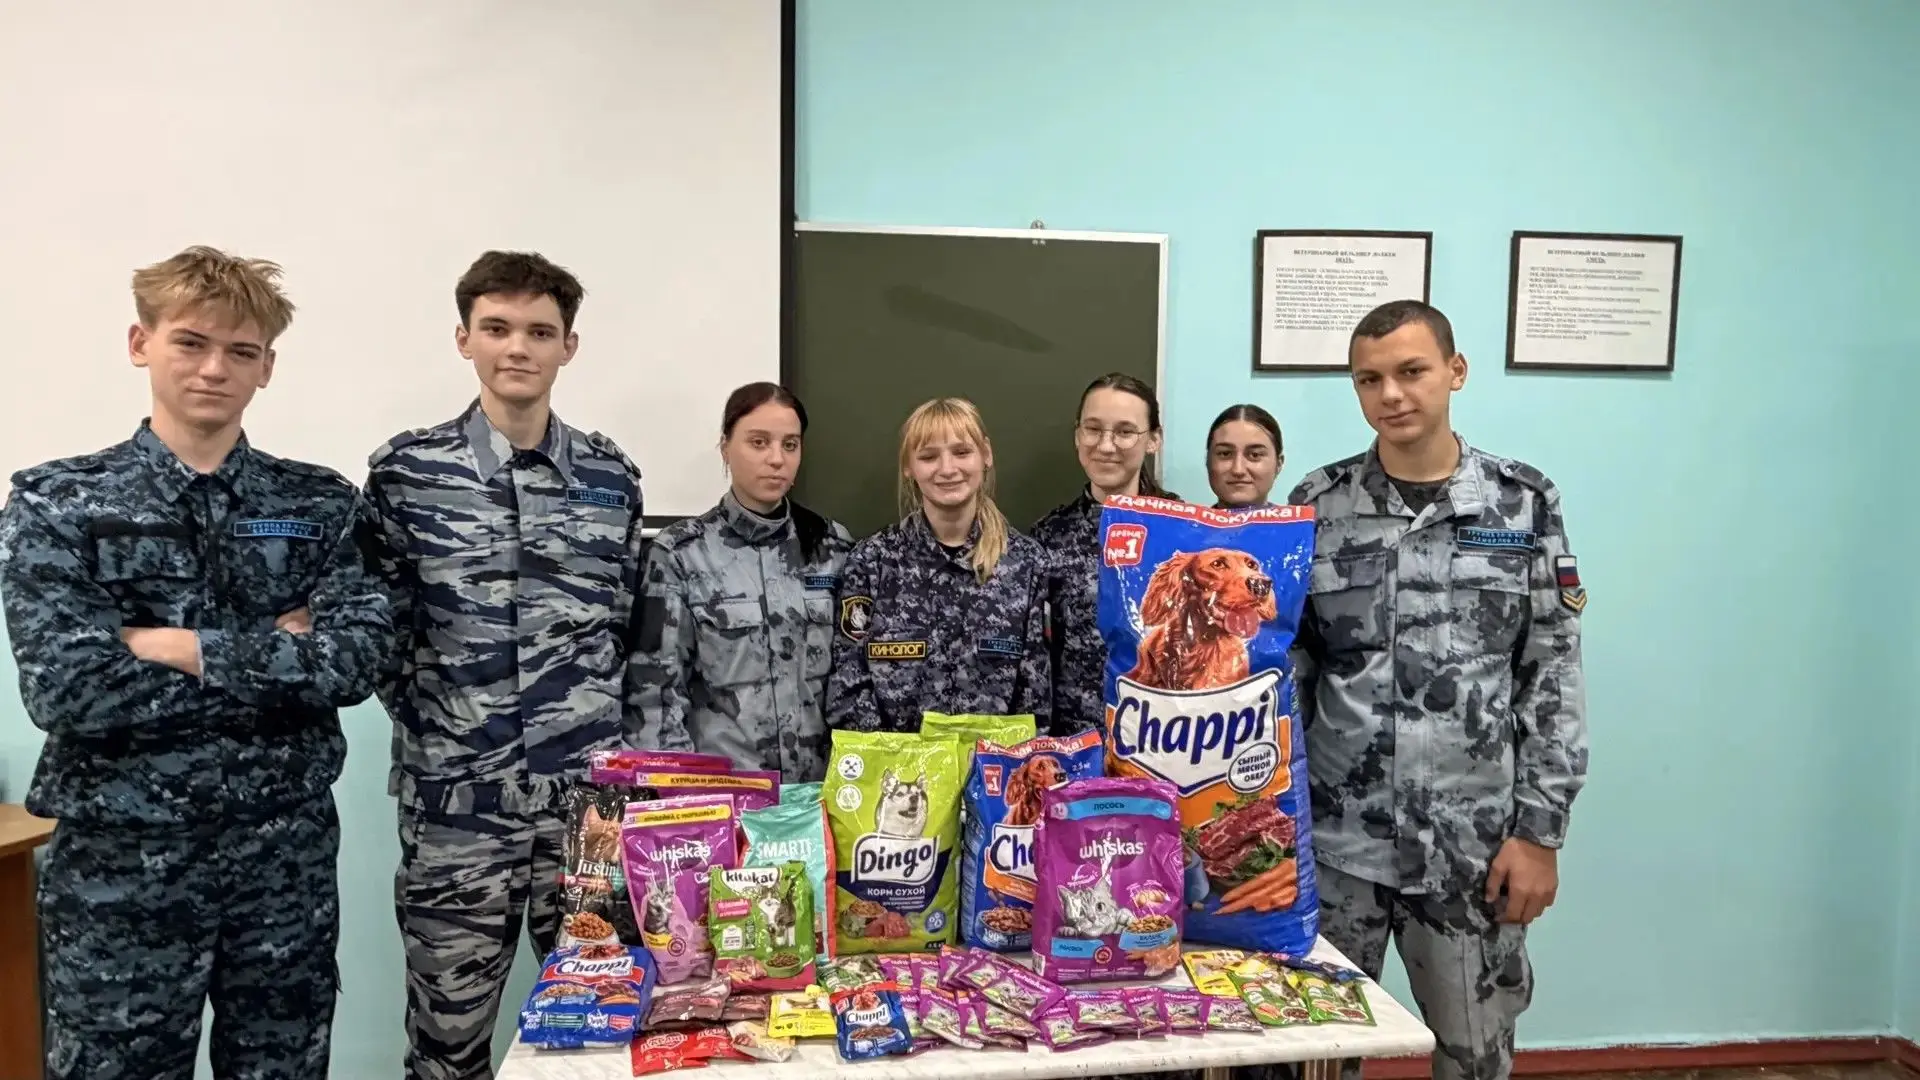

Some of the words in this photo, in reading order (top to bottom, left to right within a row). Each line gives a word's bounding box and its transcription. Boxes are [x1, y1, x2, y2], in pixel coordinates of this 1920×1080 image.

[871, 644, 922, 656] КИНОЛОГ
[1113, 691, 1271, 765] Chappi
[1237, 750, 1271, 766] СЫТНЫЙ
[1237, 760, 1271, 775] МЯСНОЙ
[651, 842, 711, 862] whiskas
[1080, 838, 1144, 859] whiskas
[859, 843, 932, 878] Dingo
[867, 888, 893, 896] КОРМ
[895, 886, 926, 896] СУХОЙ
[557, 960, 628, 973] Chappi
[846, 1007, 886, 1022] Chappi
